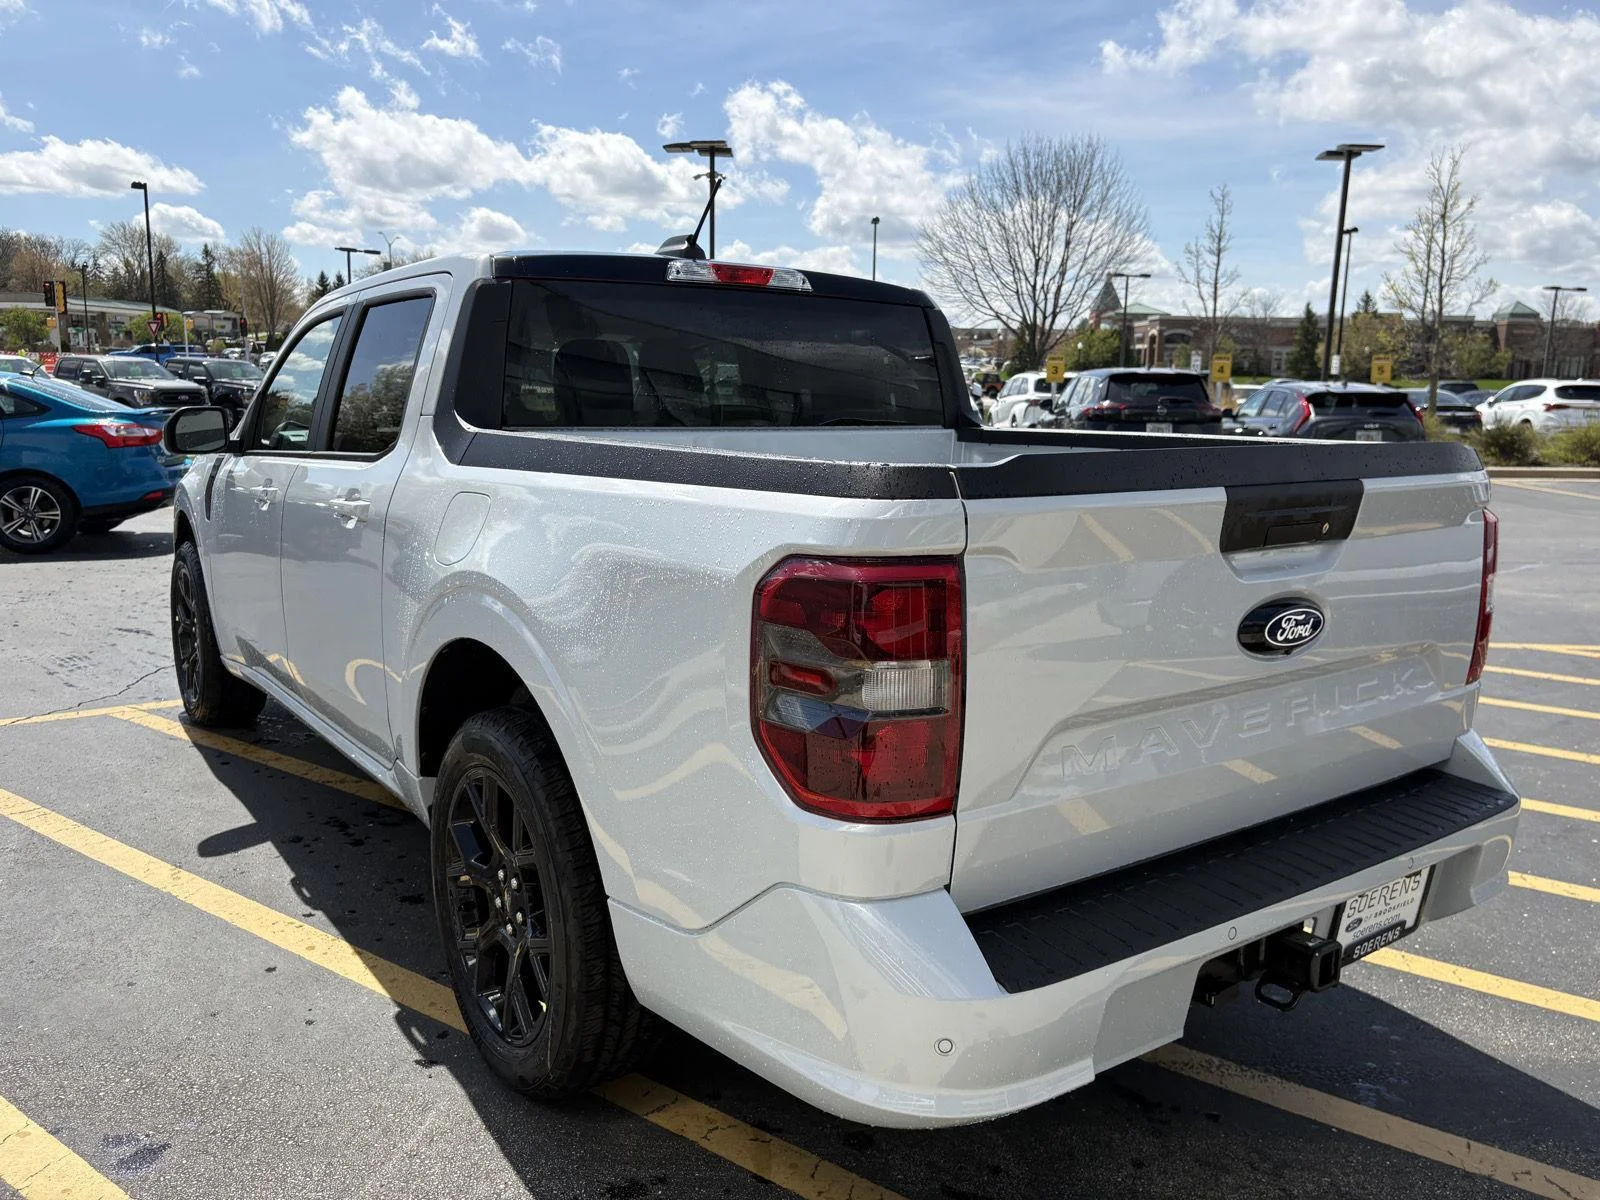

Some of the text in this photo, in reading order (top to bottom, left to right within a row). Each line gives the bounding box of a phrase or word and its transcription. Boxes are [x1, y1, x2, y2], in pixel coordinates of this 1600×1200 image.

[1051, 366, 1058, 374] 3
[1218, 364, 1225, 374] 4
[1277, 614, 1314, 641] Ford
[1061, 667, 1436, 778] MAVERICK
[1347, 875, 1421, 919] SOERENS
[1353, 926, 1401, 959] SOERENS
